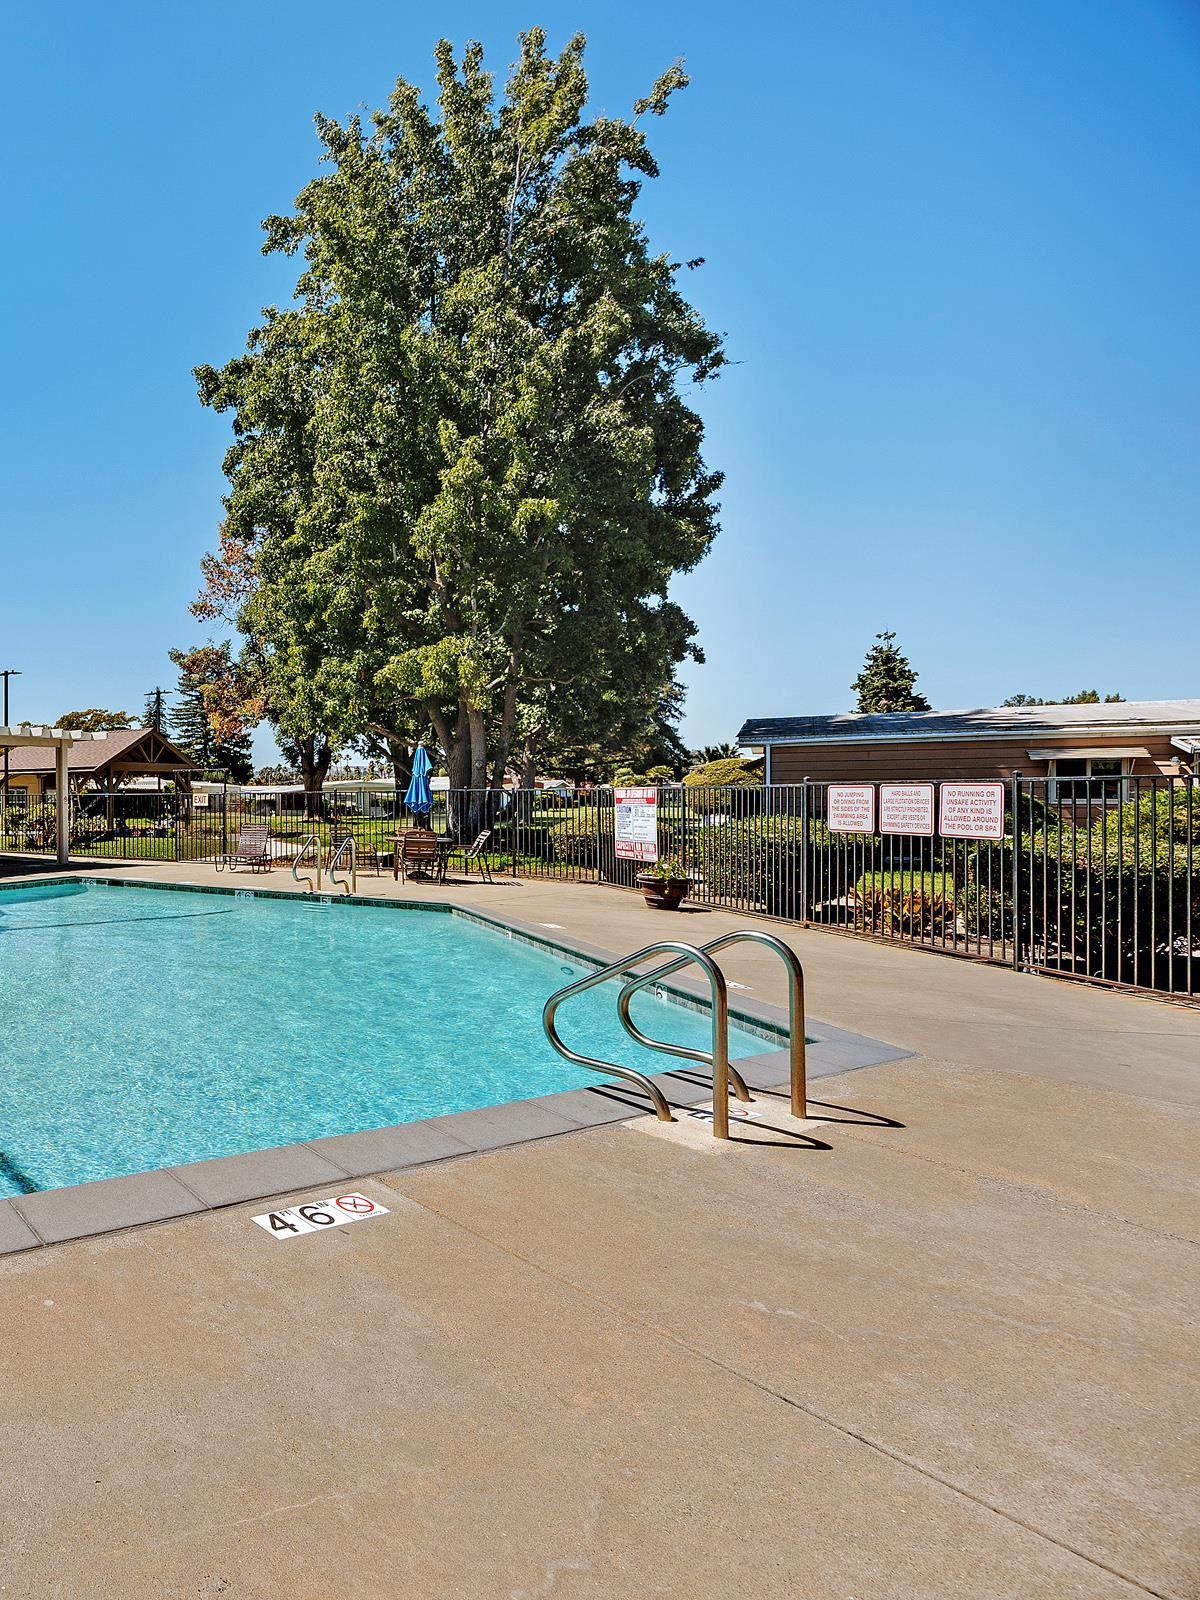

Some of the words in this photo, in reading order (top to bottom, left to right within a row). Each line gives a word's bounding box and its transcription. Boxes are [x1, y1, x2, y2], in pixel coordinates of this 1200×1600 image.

[194, 795, 207, 803] EXIT
[656, 985, 662, 999] 6
[269, 1213, 300, 1233] 4
[299, 1205, 335, 1225] 6
